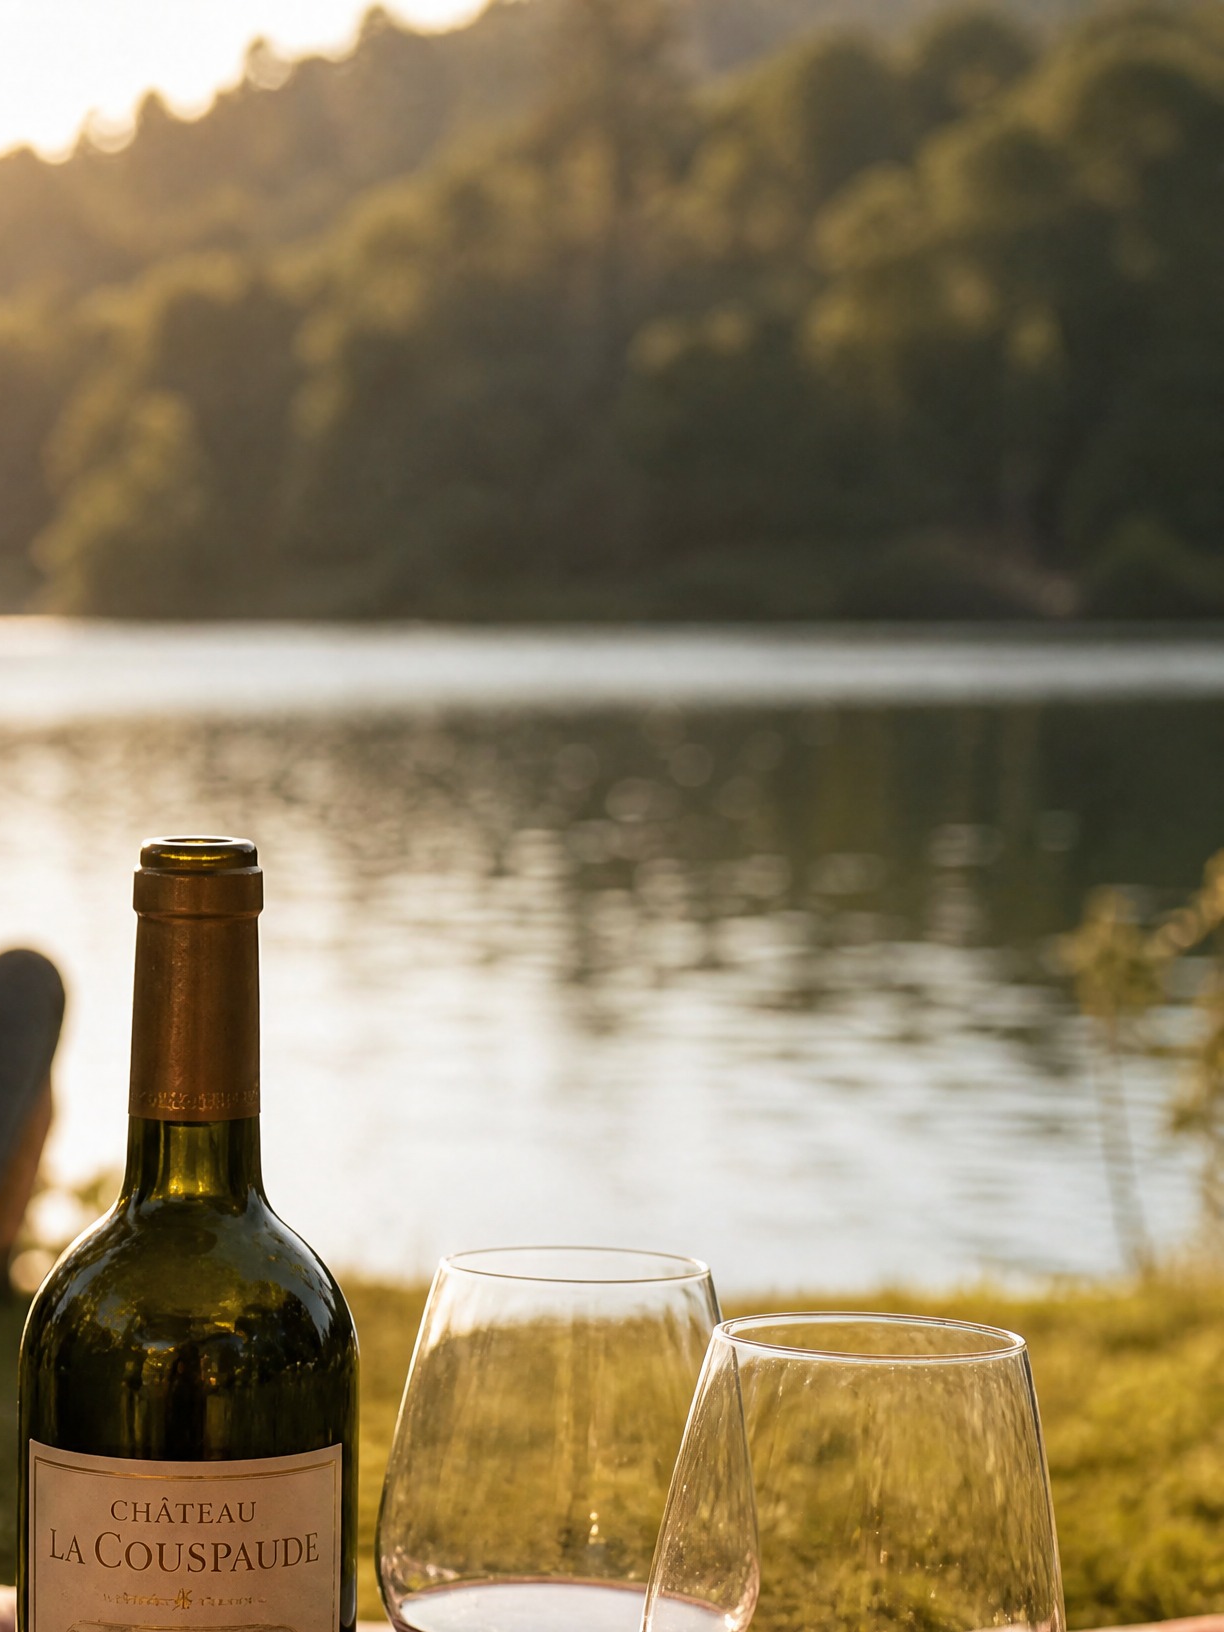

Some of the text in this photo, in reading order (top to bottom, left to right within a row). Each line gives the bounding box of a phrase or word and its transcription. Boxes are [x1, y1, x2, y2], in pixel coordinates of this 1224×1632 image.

[110, 1497, 256, 1524] CHÂTEAU
[49, 1528, 320, 1573] LA COUSPAUDE
